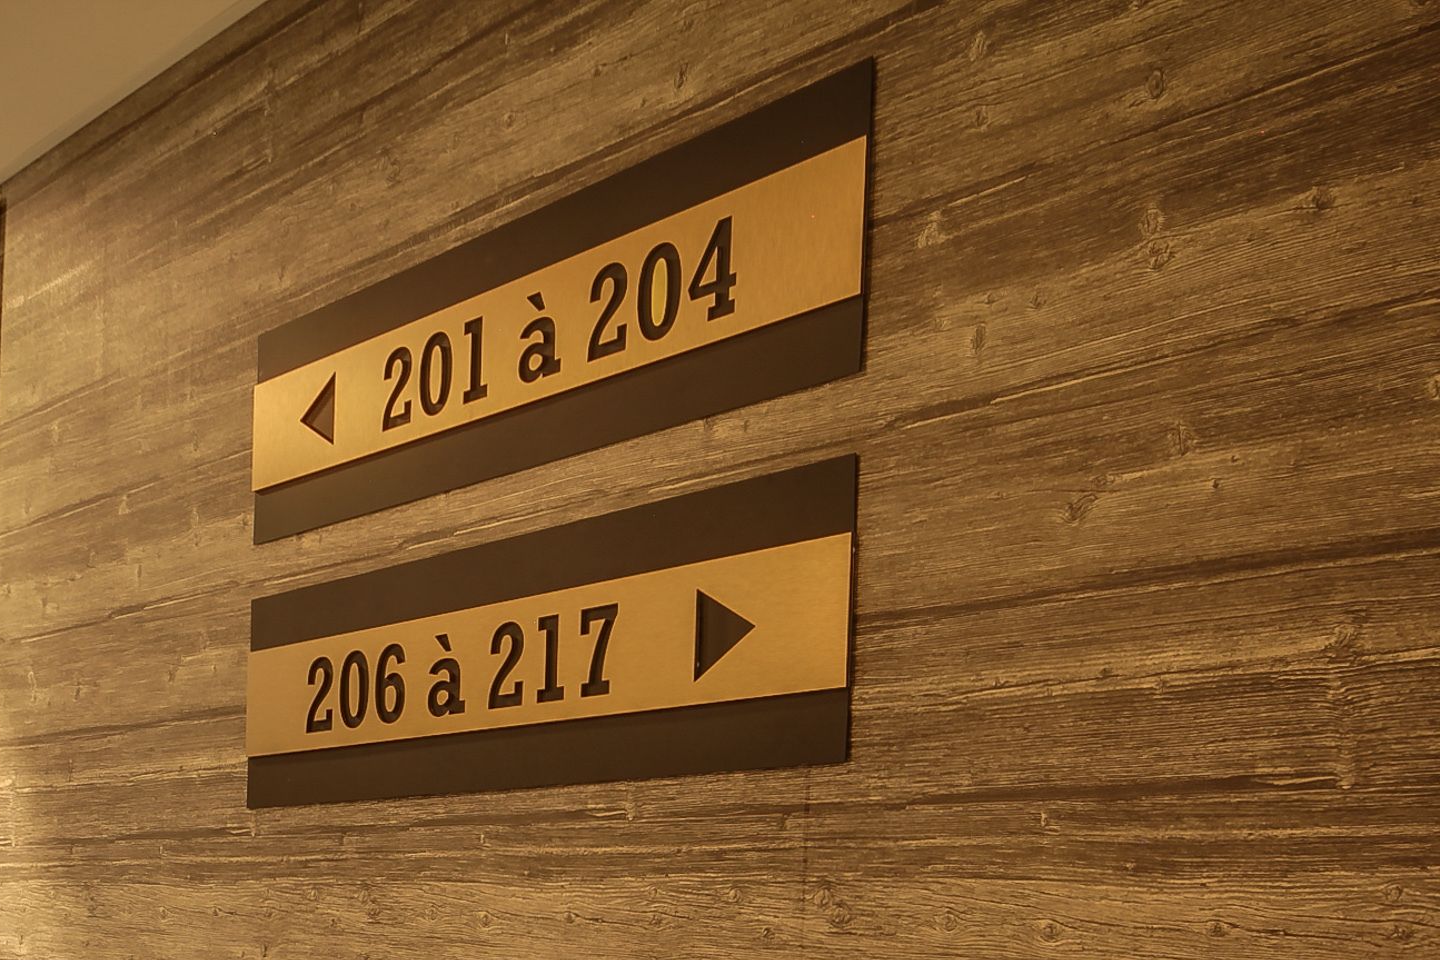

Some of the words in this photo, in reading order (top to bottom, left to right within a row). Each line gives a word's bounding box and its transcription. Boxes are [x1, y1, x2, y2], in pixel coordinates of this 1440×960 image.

[381, 315, 489, 433] 201
[518, 292, 561, 385] à
[586, 215, 737, 364] 204
[305, 642, 407, 734] 206
[427, 633, 466, 718] à
[487, 602, 620, 710] 217
